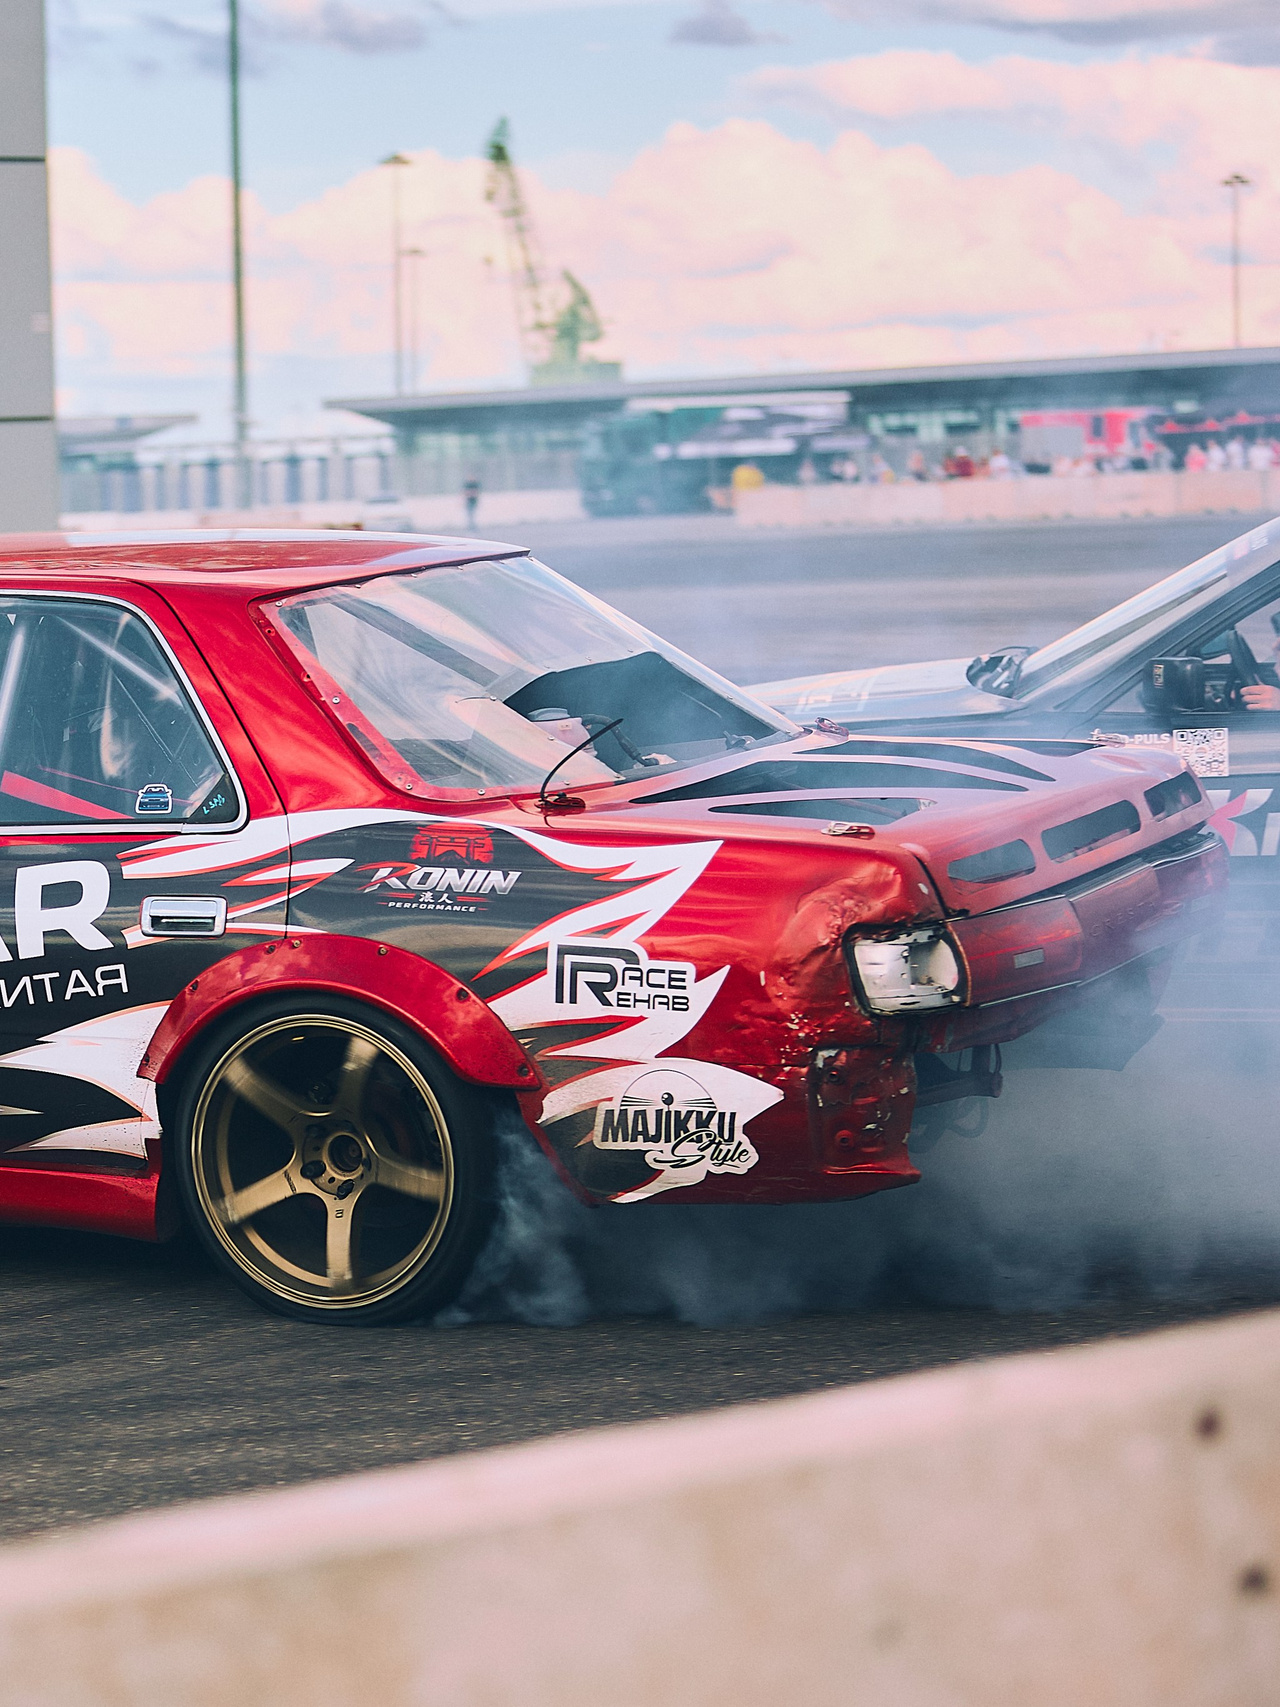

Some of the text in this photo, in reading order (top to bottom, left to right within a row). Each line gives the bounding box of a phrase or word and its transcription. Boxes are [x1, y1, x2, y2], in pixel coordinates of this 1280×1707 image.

[353, 861, 522, 895] RONIN
[388, 901, 476, 913] PERFORMANCE
[601, 1108, 736, 1143] MAJIKKU
[653, 1128, 751, 1169] Style
